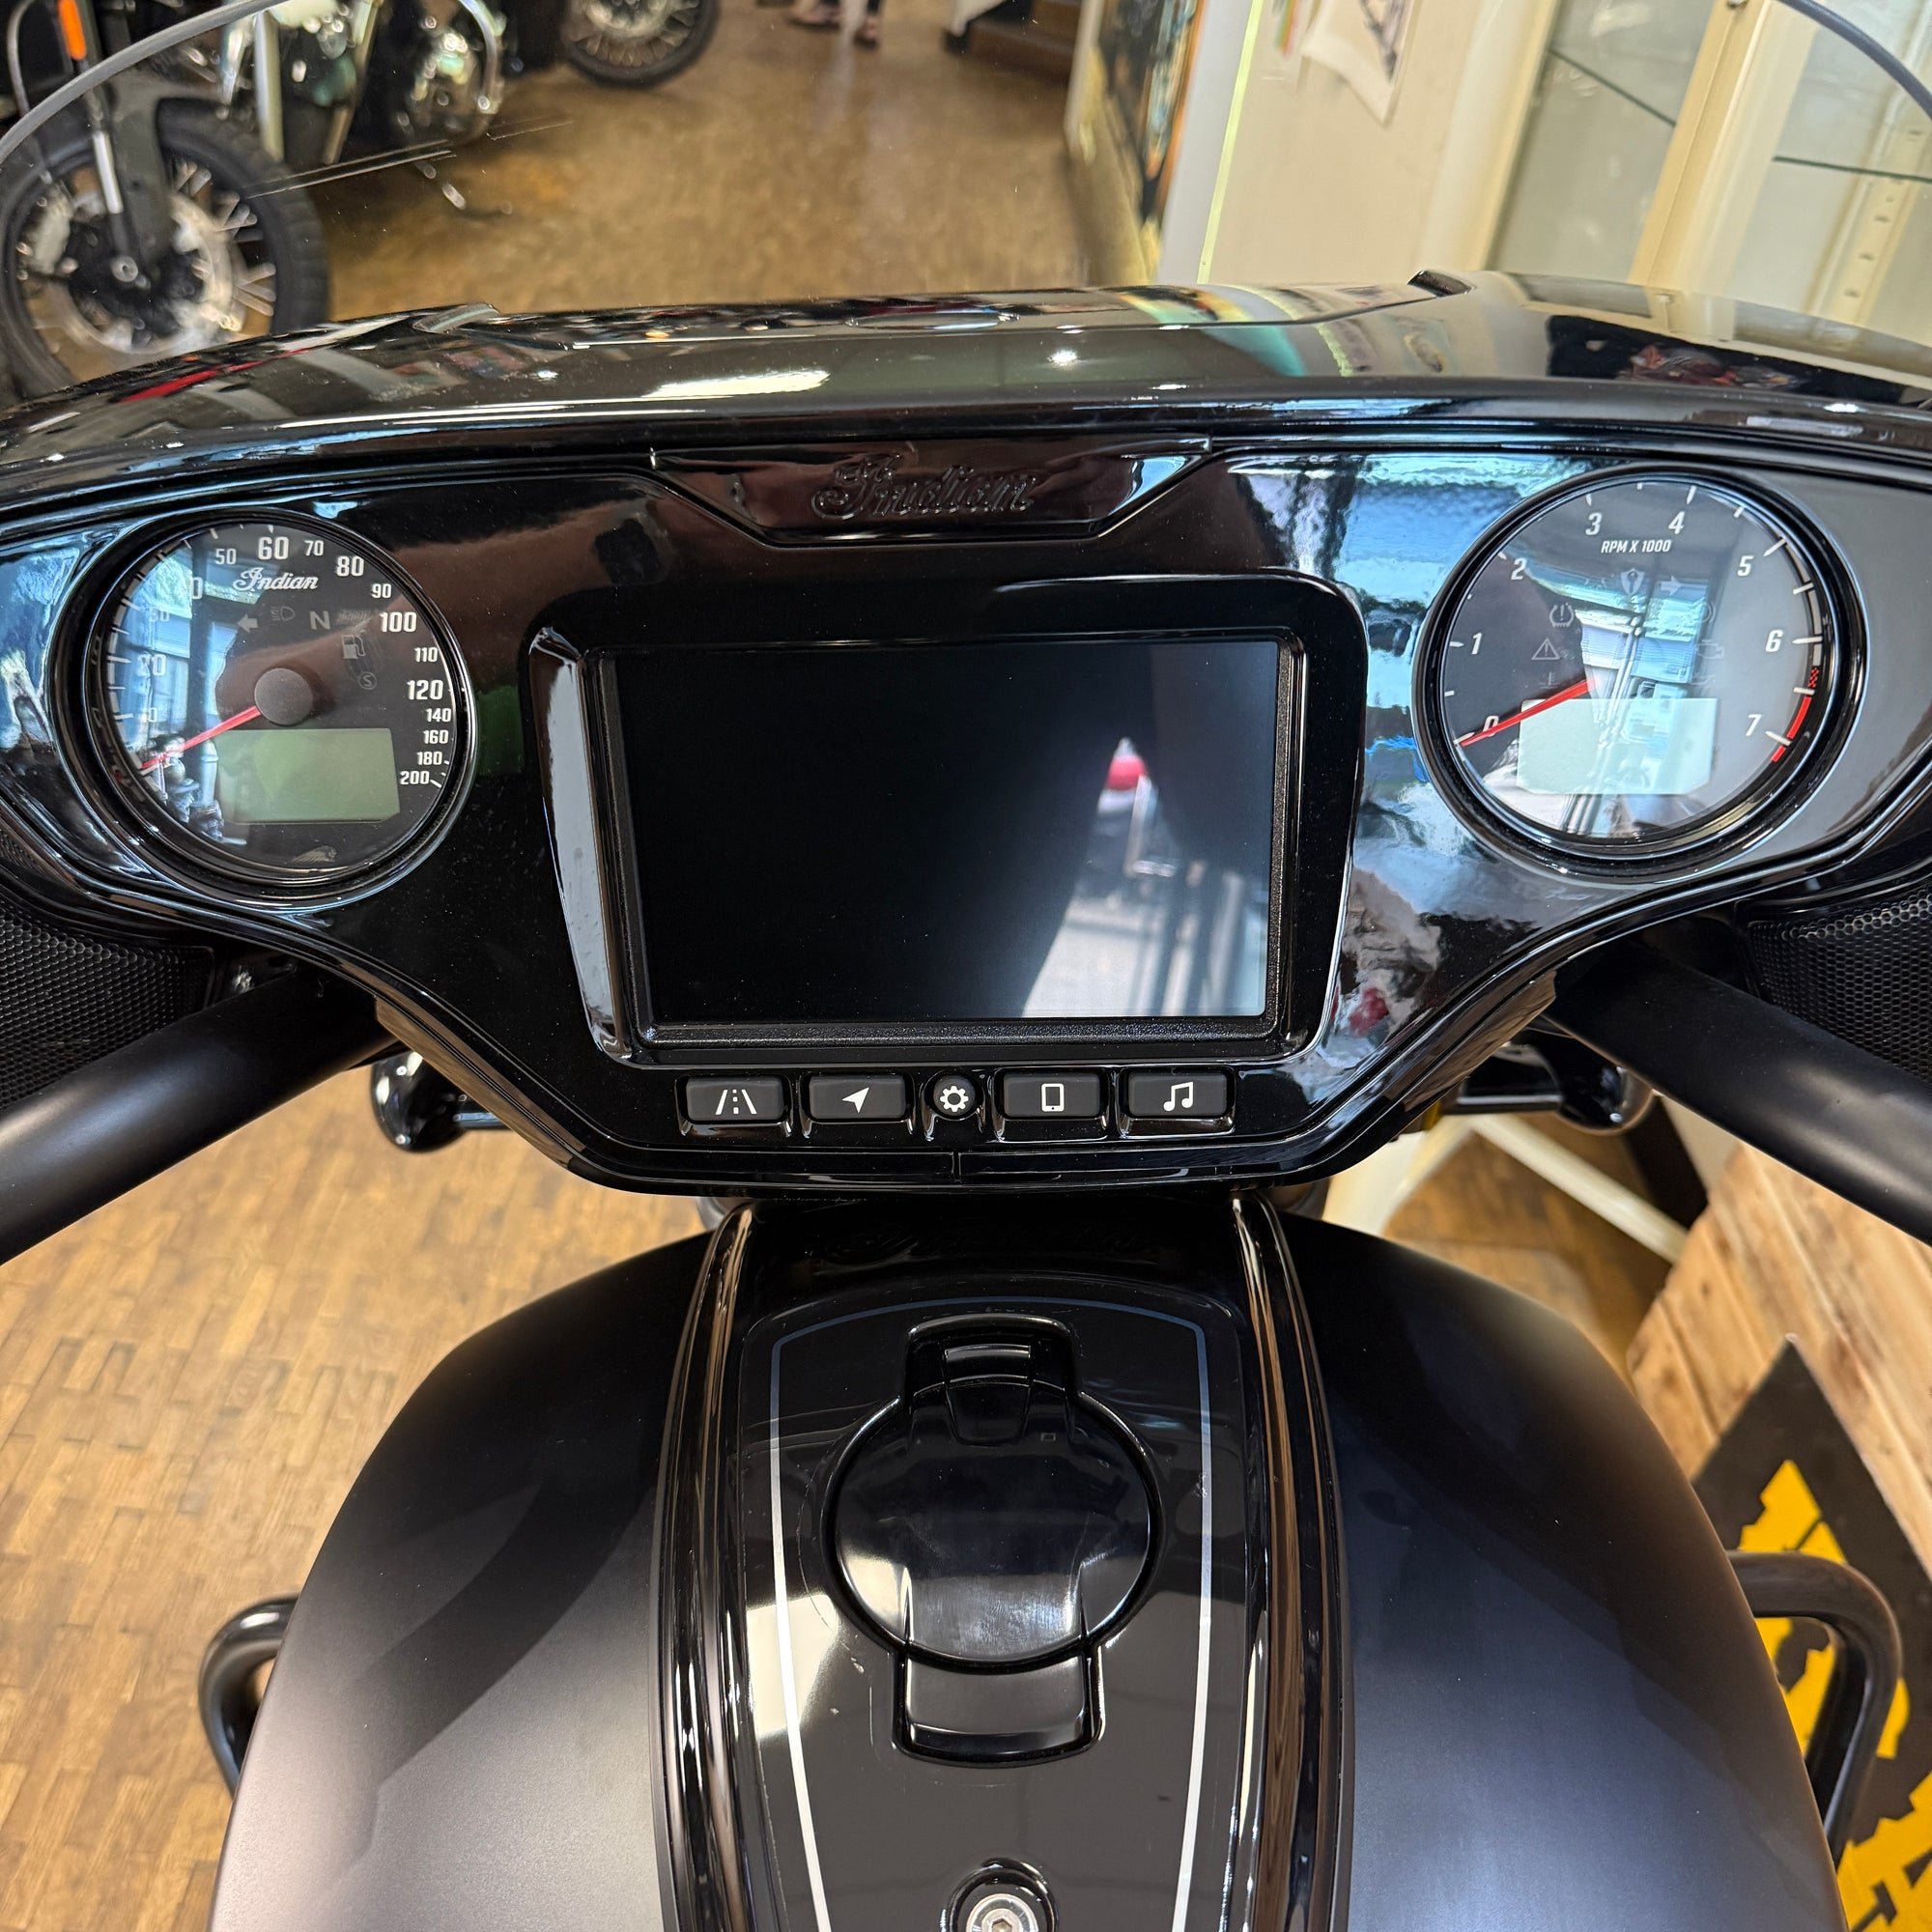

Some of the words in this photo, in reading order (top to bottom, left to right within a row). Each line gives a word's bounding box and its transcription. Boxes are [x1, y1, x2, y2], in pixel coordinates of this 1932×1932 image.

[811, 452, 1035, 520] Indian
[1585, 512, 1603, 535] 3
[1668, 511, 1685, 534] 4
[215, 549, 237, 564] 50
[258, 537, 289, 559] 60
[304, 540, 324, 555] 70
[1601, 540, 1629, 554] RPM
[1629, 540, 1640, 554] X
[1641, 539, 1672, 553] 1000
[336, 555, 364, 576] 80
[1511, 558, 1528, 581] 2
[1738, 555, 1754, 577] 5
[233, 567, 319, 591] Indian
[371, 583, 392, 598] 90
[309, 611, 330, 630] N
[380, 611, 416, 632] 100
[1471, 634, 1483, 655] 1
[1765, 630, 1783, 652] 6
[138, 654, 167, 676] 20
[414, 647, 439, 663] 110
[407, 680, 443, 699] 120
[426, 708, 452, 723] 140
[1746, 714, 1762, 736] 7
[423, 730, 448, 744] 160
[1482, 716, 1499, 737] 0
[416, 752, 442, 765] 180
[400, 771, 430, 784] 200
